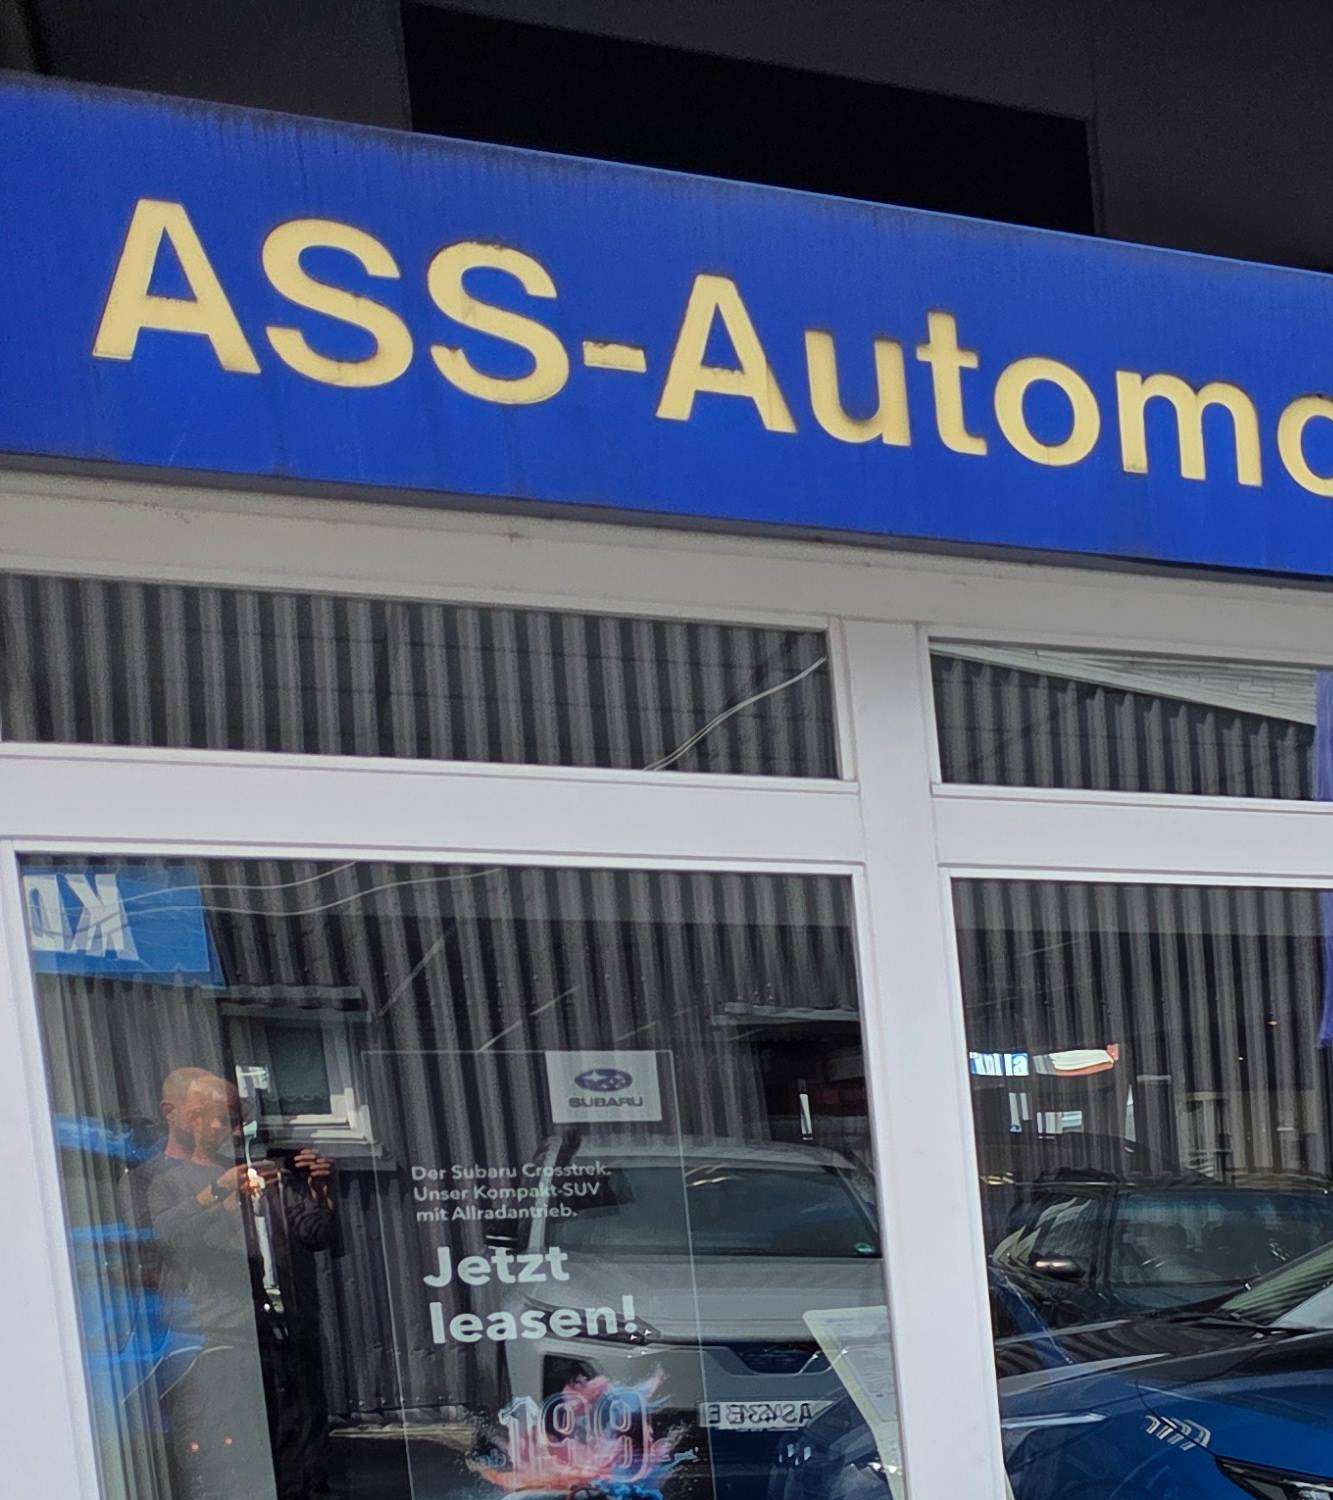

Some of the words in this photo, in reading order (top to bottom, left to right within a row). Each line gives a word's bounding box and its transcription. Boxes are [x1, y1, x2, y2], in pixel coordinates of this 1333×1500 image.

[568, 1096, 643, 1108] SUBARU
[411, 1166, 446, 1180] Der
[451, 1163, 517, 1180] Subaru
[522, 1160, 612, 1179] Crosstrek.
[413, 1186, 470, 1201] Unser
[474, 1181, 600, 1203] Kompakt-SUV
[416, 1206, 448, 1222] mit
[451, 1203, 578, 1221] Allradantrieb.
[423, 1246, 570, 1288] Jetzt
[429, 1294, 638, 1345] leasen!
